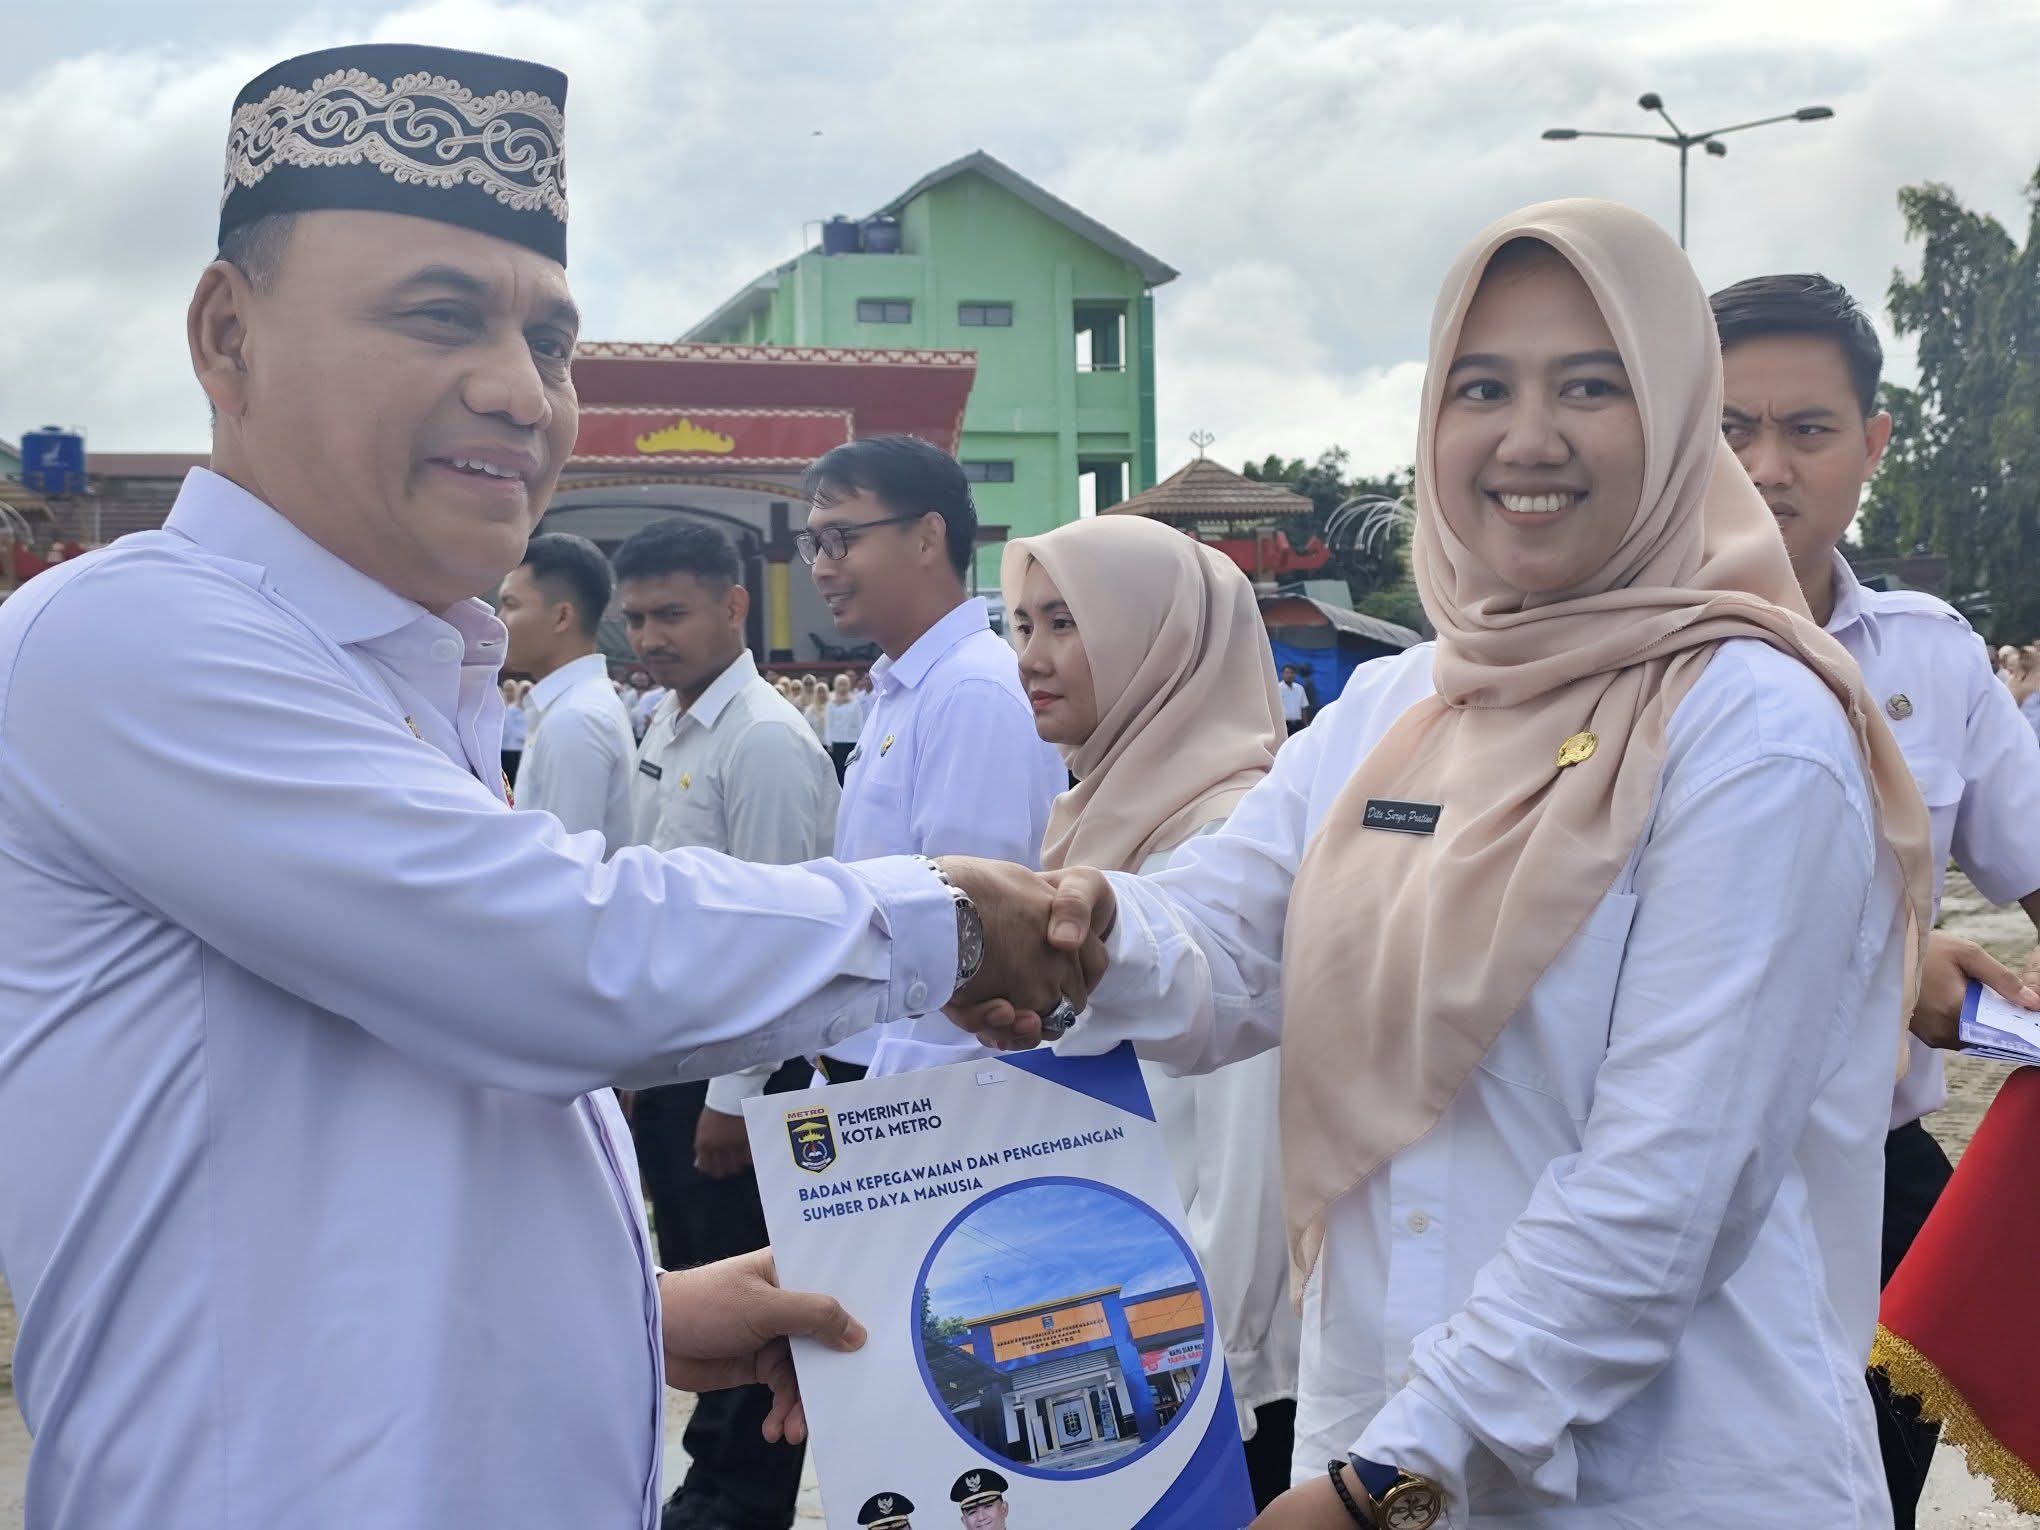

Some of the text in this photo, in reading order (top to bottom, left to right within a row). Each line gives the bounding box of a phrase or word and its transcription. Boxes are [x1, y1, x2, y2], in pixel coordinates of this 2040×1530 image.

[787, 1108, 825, 1119] METRO
[838, 1098, 932, 1126] PEMERINTAH
[841, 1115, 942, 1145] KOTA METRO
[799, 1126, 1124, 1201] BADAN KEPEGAWAIAN DAN PENGEMBANGAN
[803, 1177, 983, 1222] SUMBER DAYA MANUSIA
